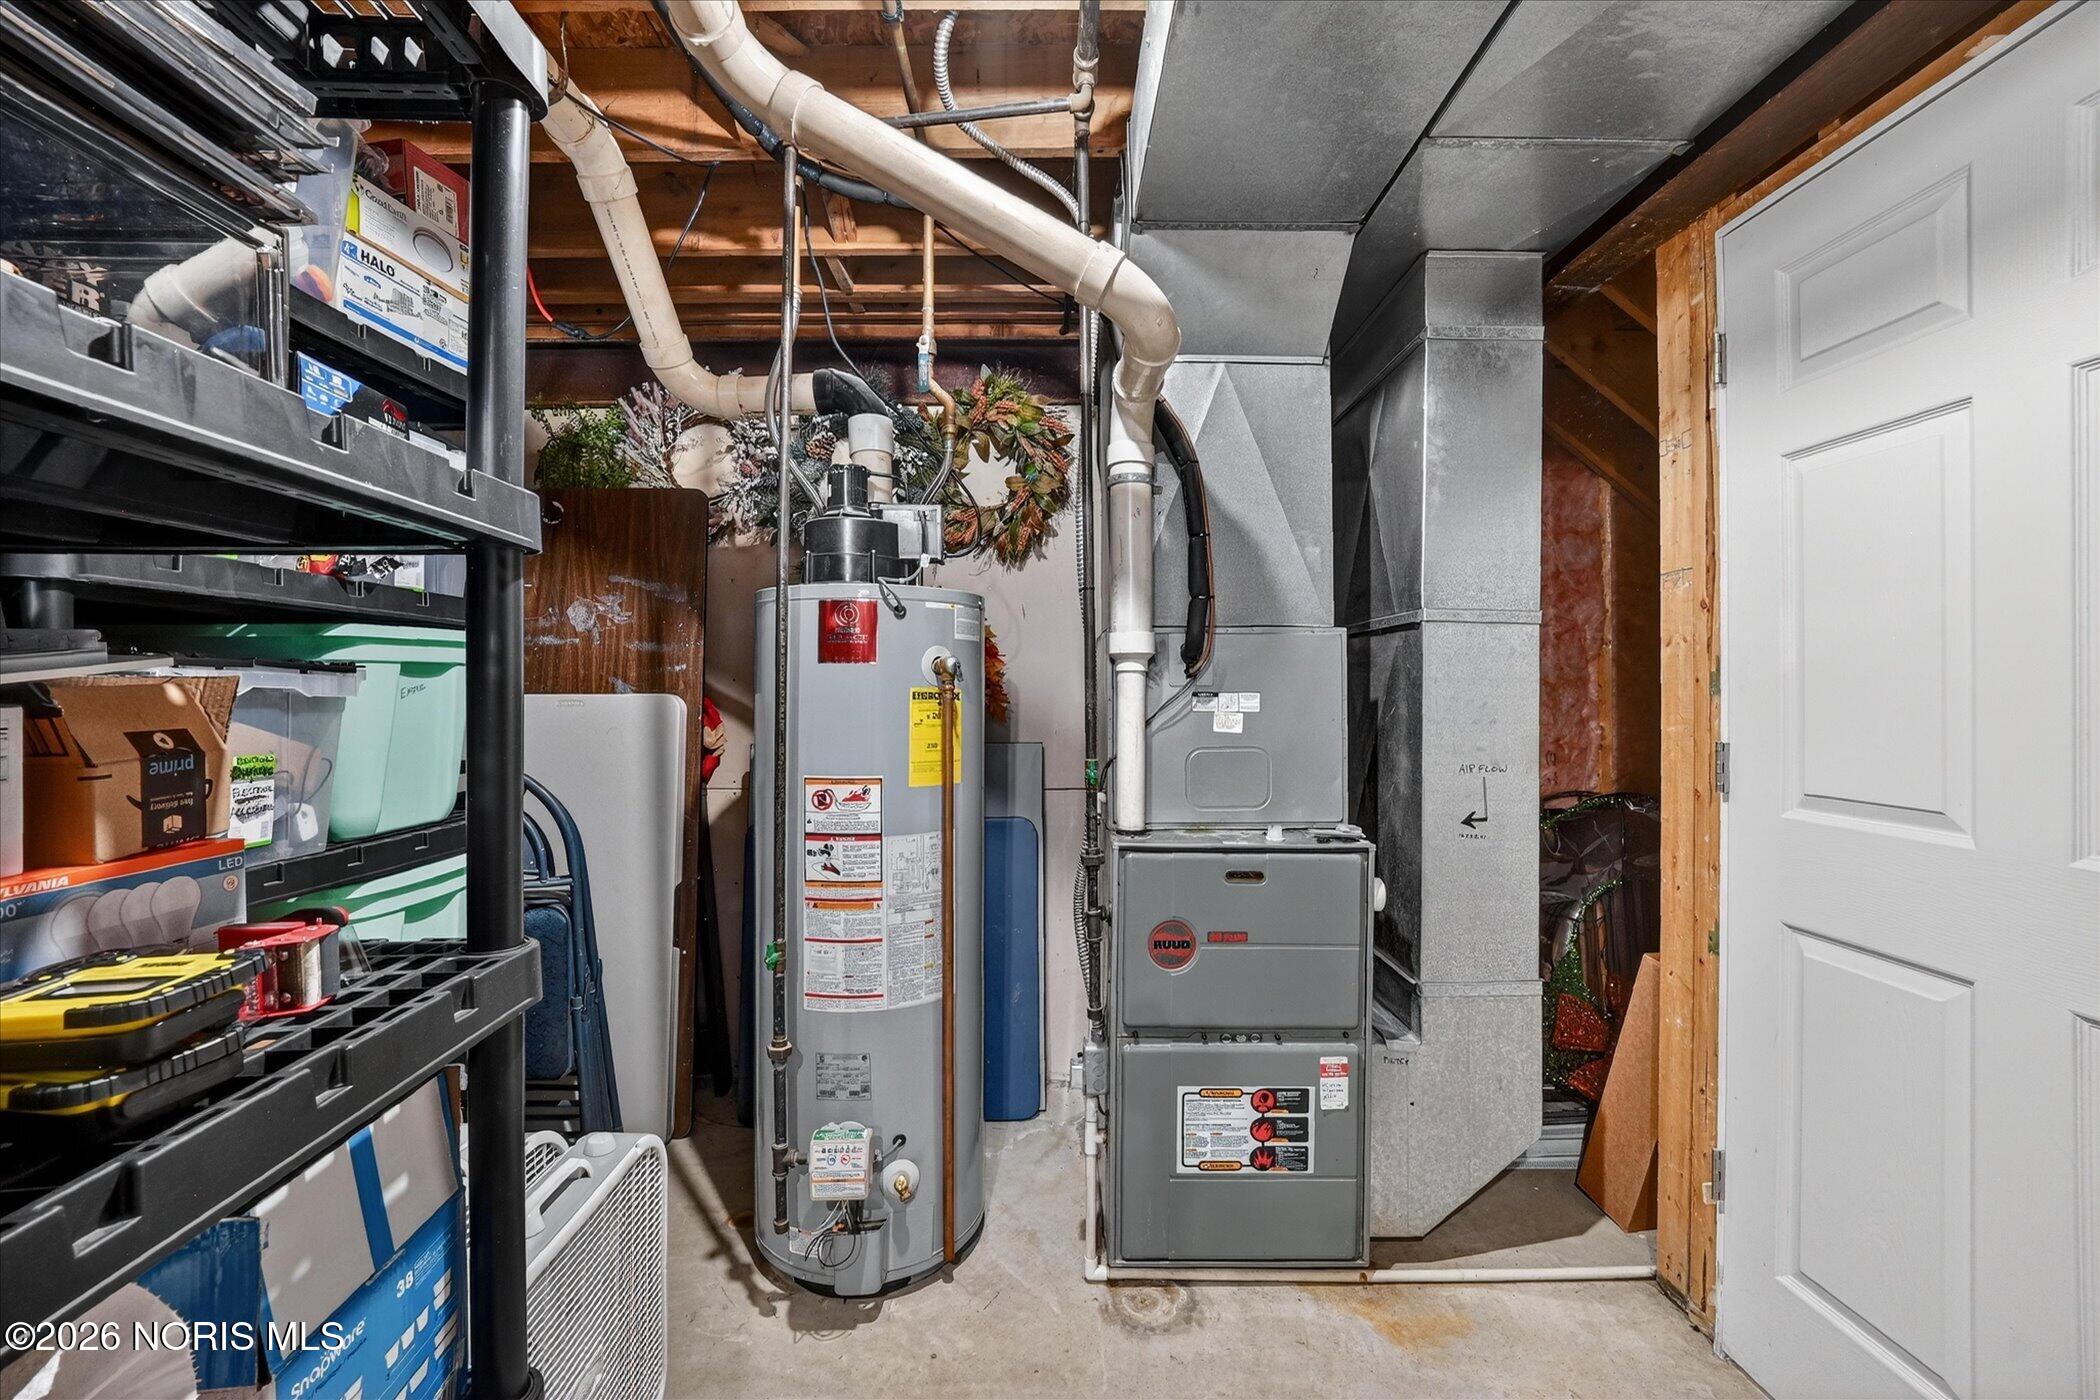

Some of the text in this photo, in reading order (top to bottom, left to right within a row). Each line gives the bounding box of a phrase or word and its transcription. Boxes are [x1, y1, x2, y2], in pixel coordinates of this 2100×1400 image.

[360, 249, 395, 278] HALO
[149, 753, 194, 776] prime
[1478, 764, 1508, 774] FLOW
[218, 856, 243, 871] LED
[1153, 940, 1191, 949] RUUD
[396, 1270, 414, 1299] 38
[291, 1319, 366, 1398] snapware
